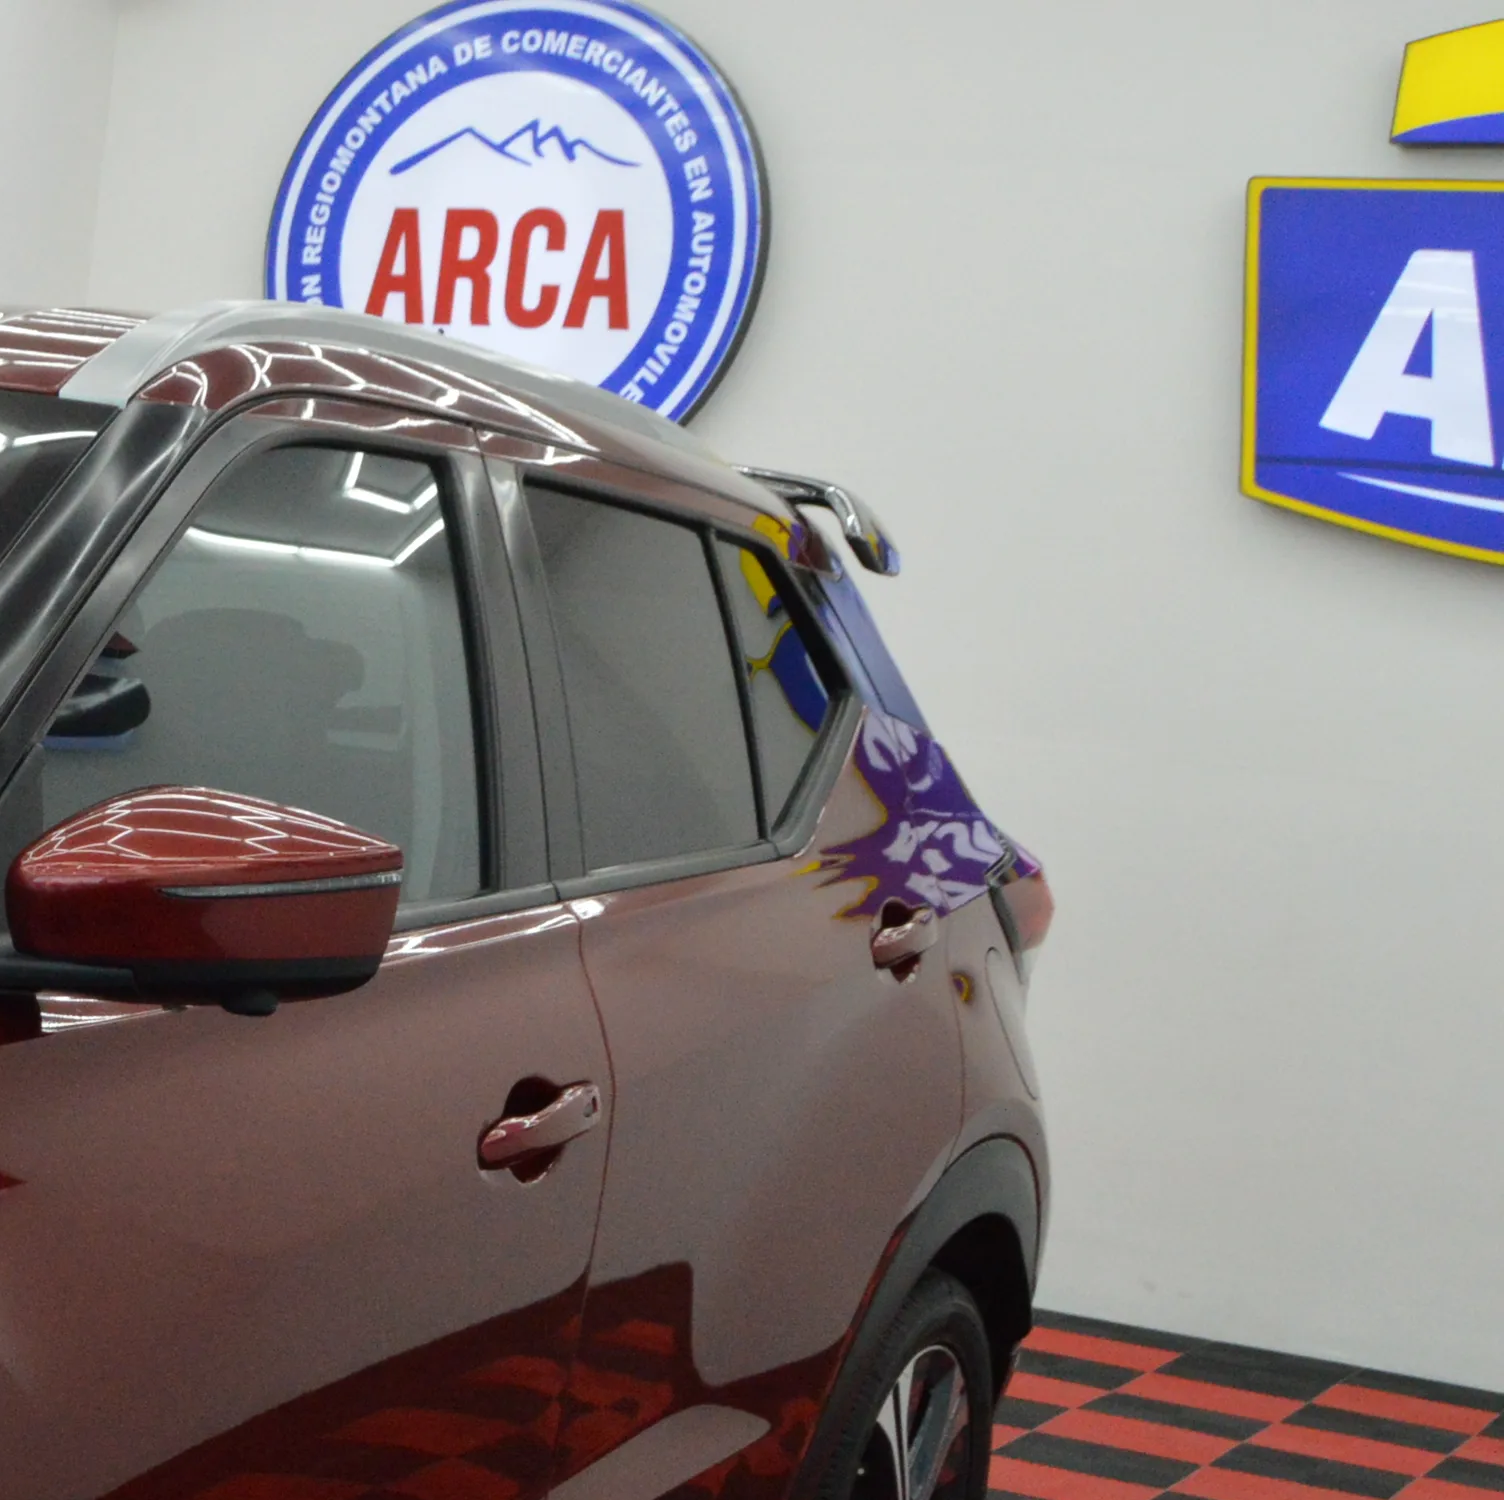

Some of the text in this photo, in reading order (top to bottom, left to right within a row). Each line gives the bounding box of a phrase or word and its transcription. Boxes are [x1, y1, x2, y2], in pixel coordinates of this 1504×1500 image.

[302, 57, 447, 265] REGIOMONTANA
[454, 35, 492, 64] DE
[501, 28, 699, 154] COMERCIANTES
[683, 156, 714, 202] EN
[364, 207, 630, 331] ARCA
[1318, 249, 1504, 468] A
